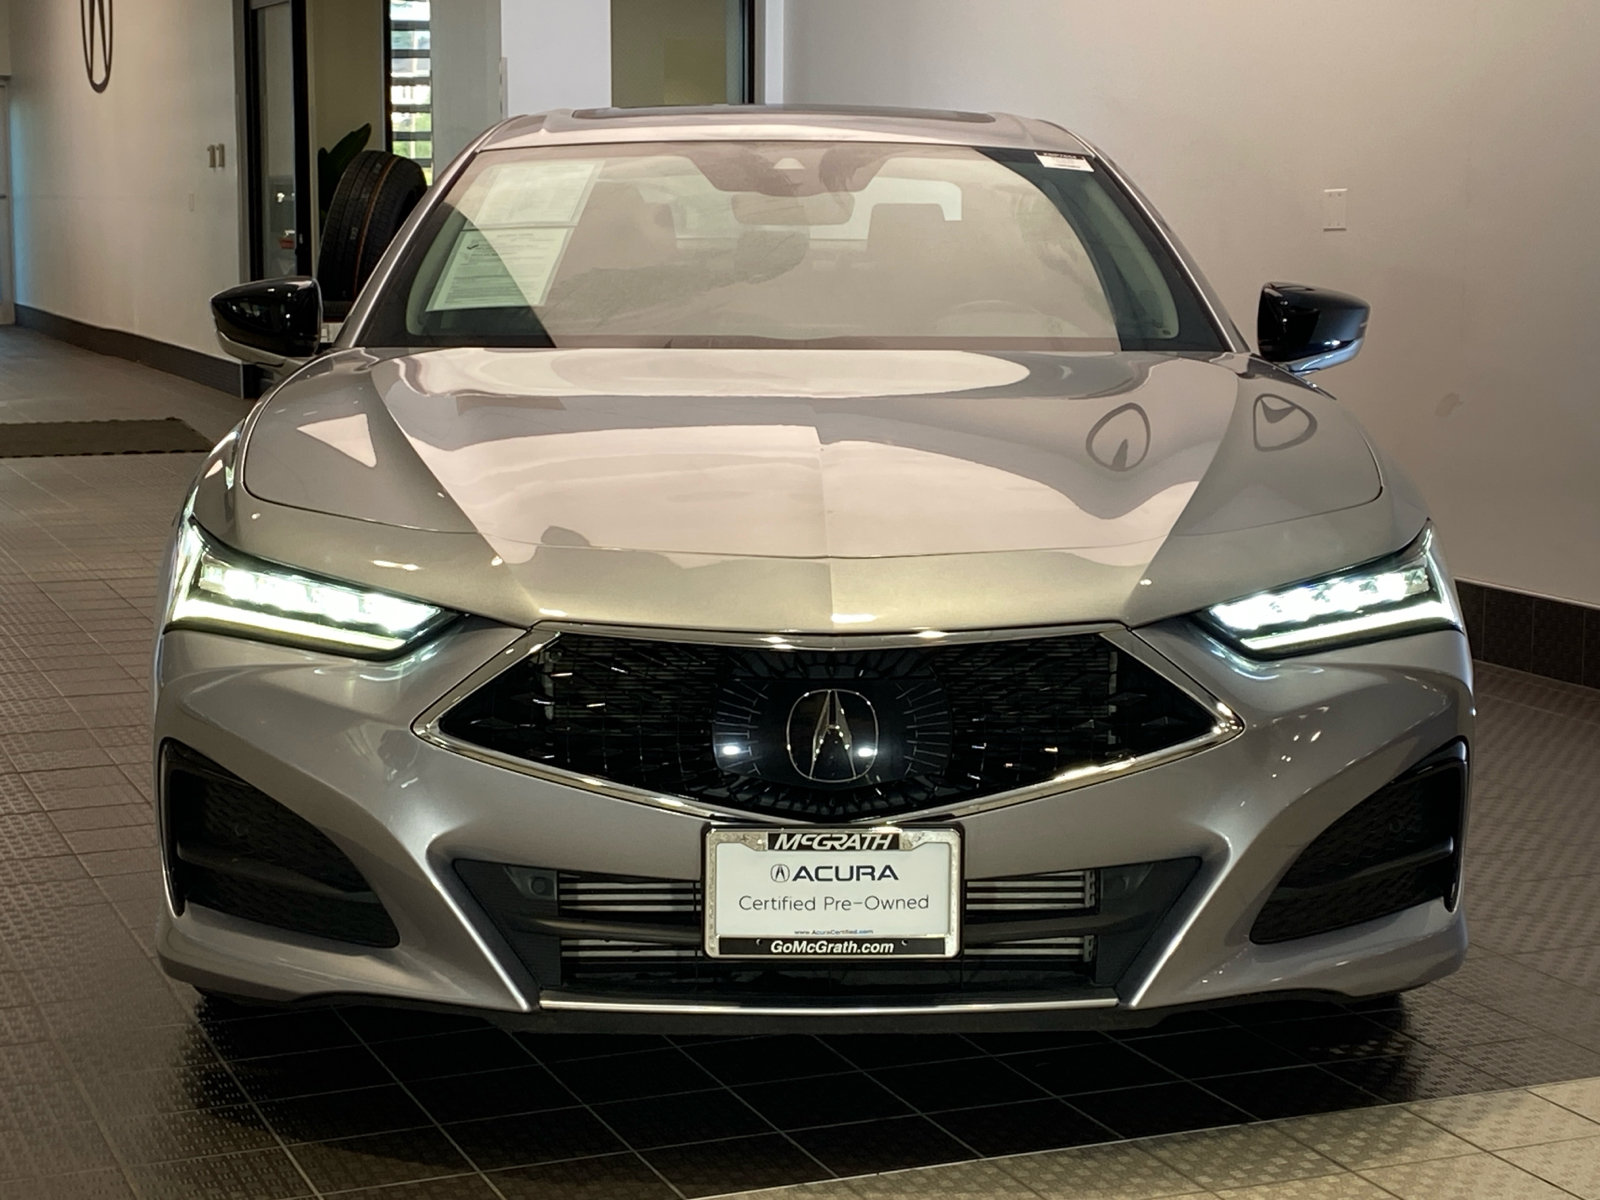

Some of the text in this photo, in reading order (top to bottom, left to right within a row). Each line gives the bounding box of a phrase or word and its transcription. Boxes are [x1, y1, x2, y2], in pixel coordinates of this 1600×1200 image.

[792, 865, 899, 882] ACURA
[739, 895, 930, 911] Certified Pre-Owned
[770, 940, 894, 954] GoMcGrath.com
